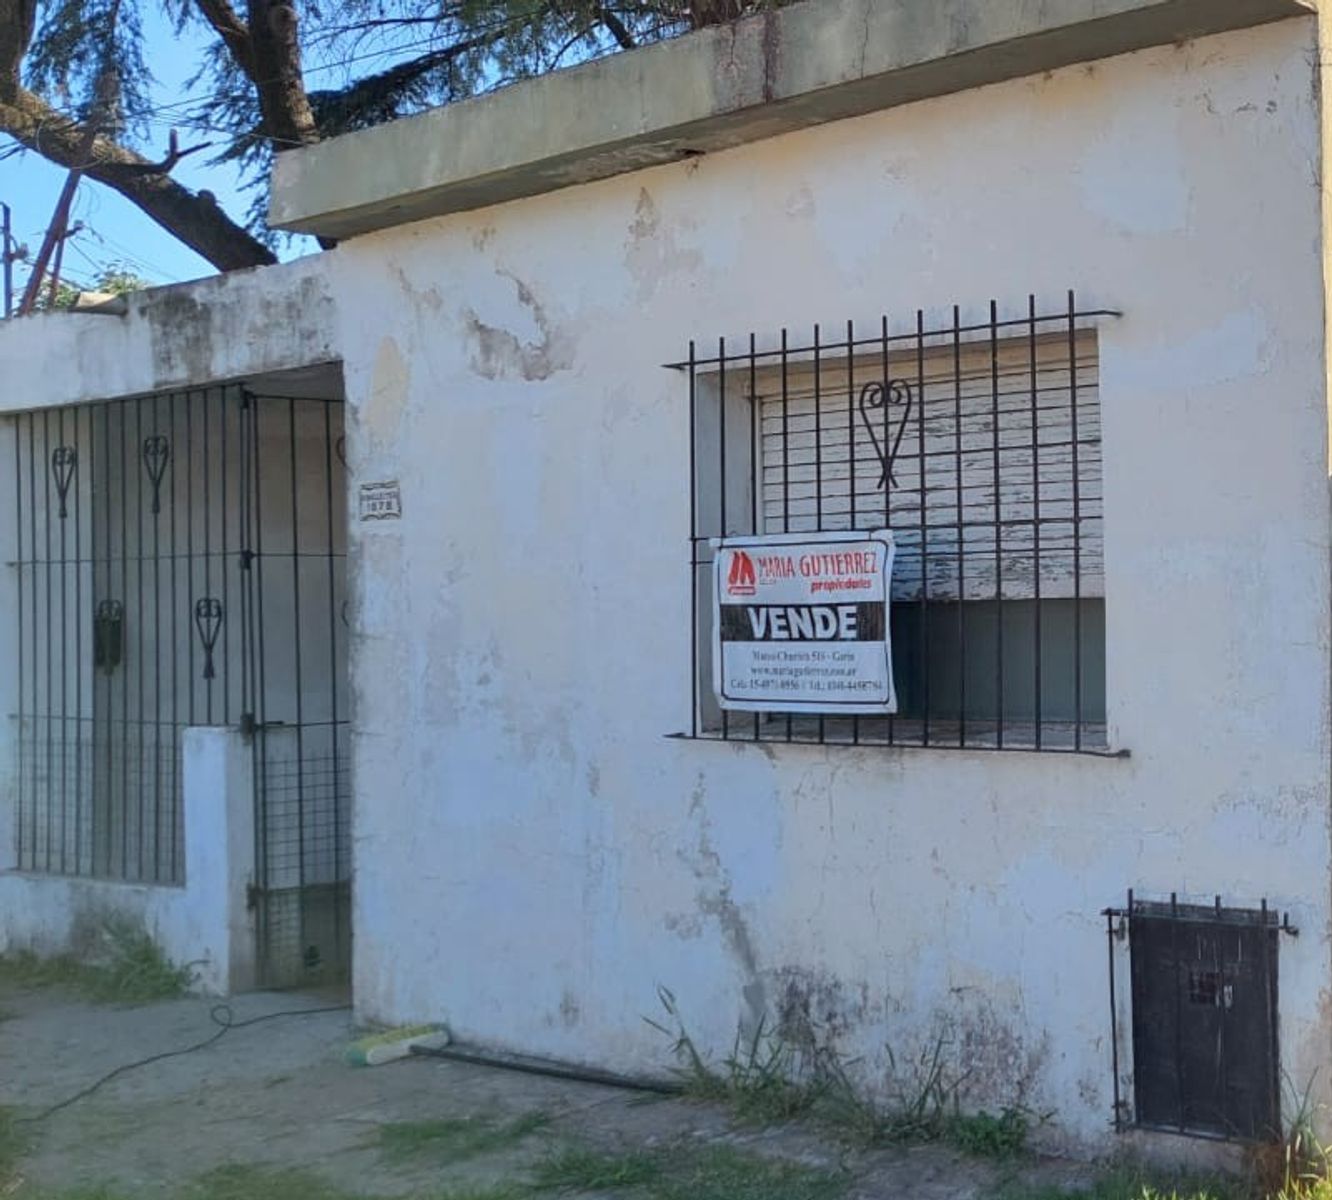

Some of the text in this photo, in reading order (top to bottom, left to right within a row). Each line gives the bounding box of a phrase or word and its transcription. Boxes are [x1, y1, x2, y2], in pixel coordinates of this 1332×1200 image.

[758, 552, 877, 578] MARIA GUTIERREZ
[811, 577, 872, 594] propiedades
[747, 605, 857, 639] VENDE
